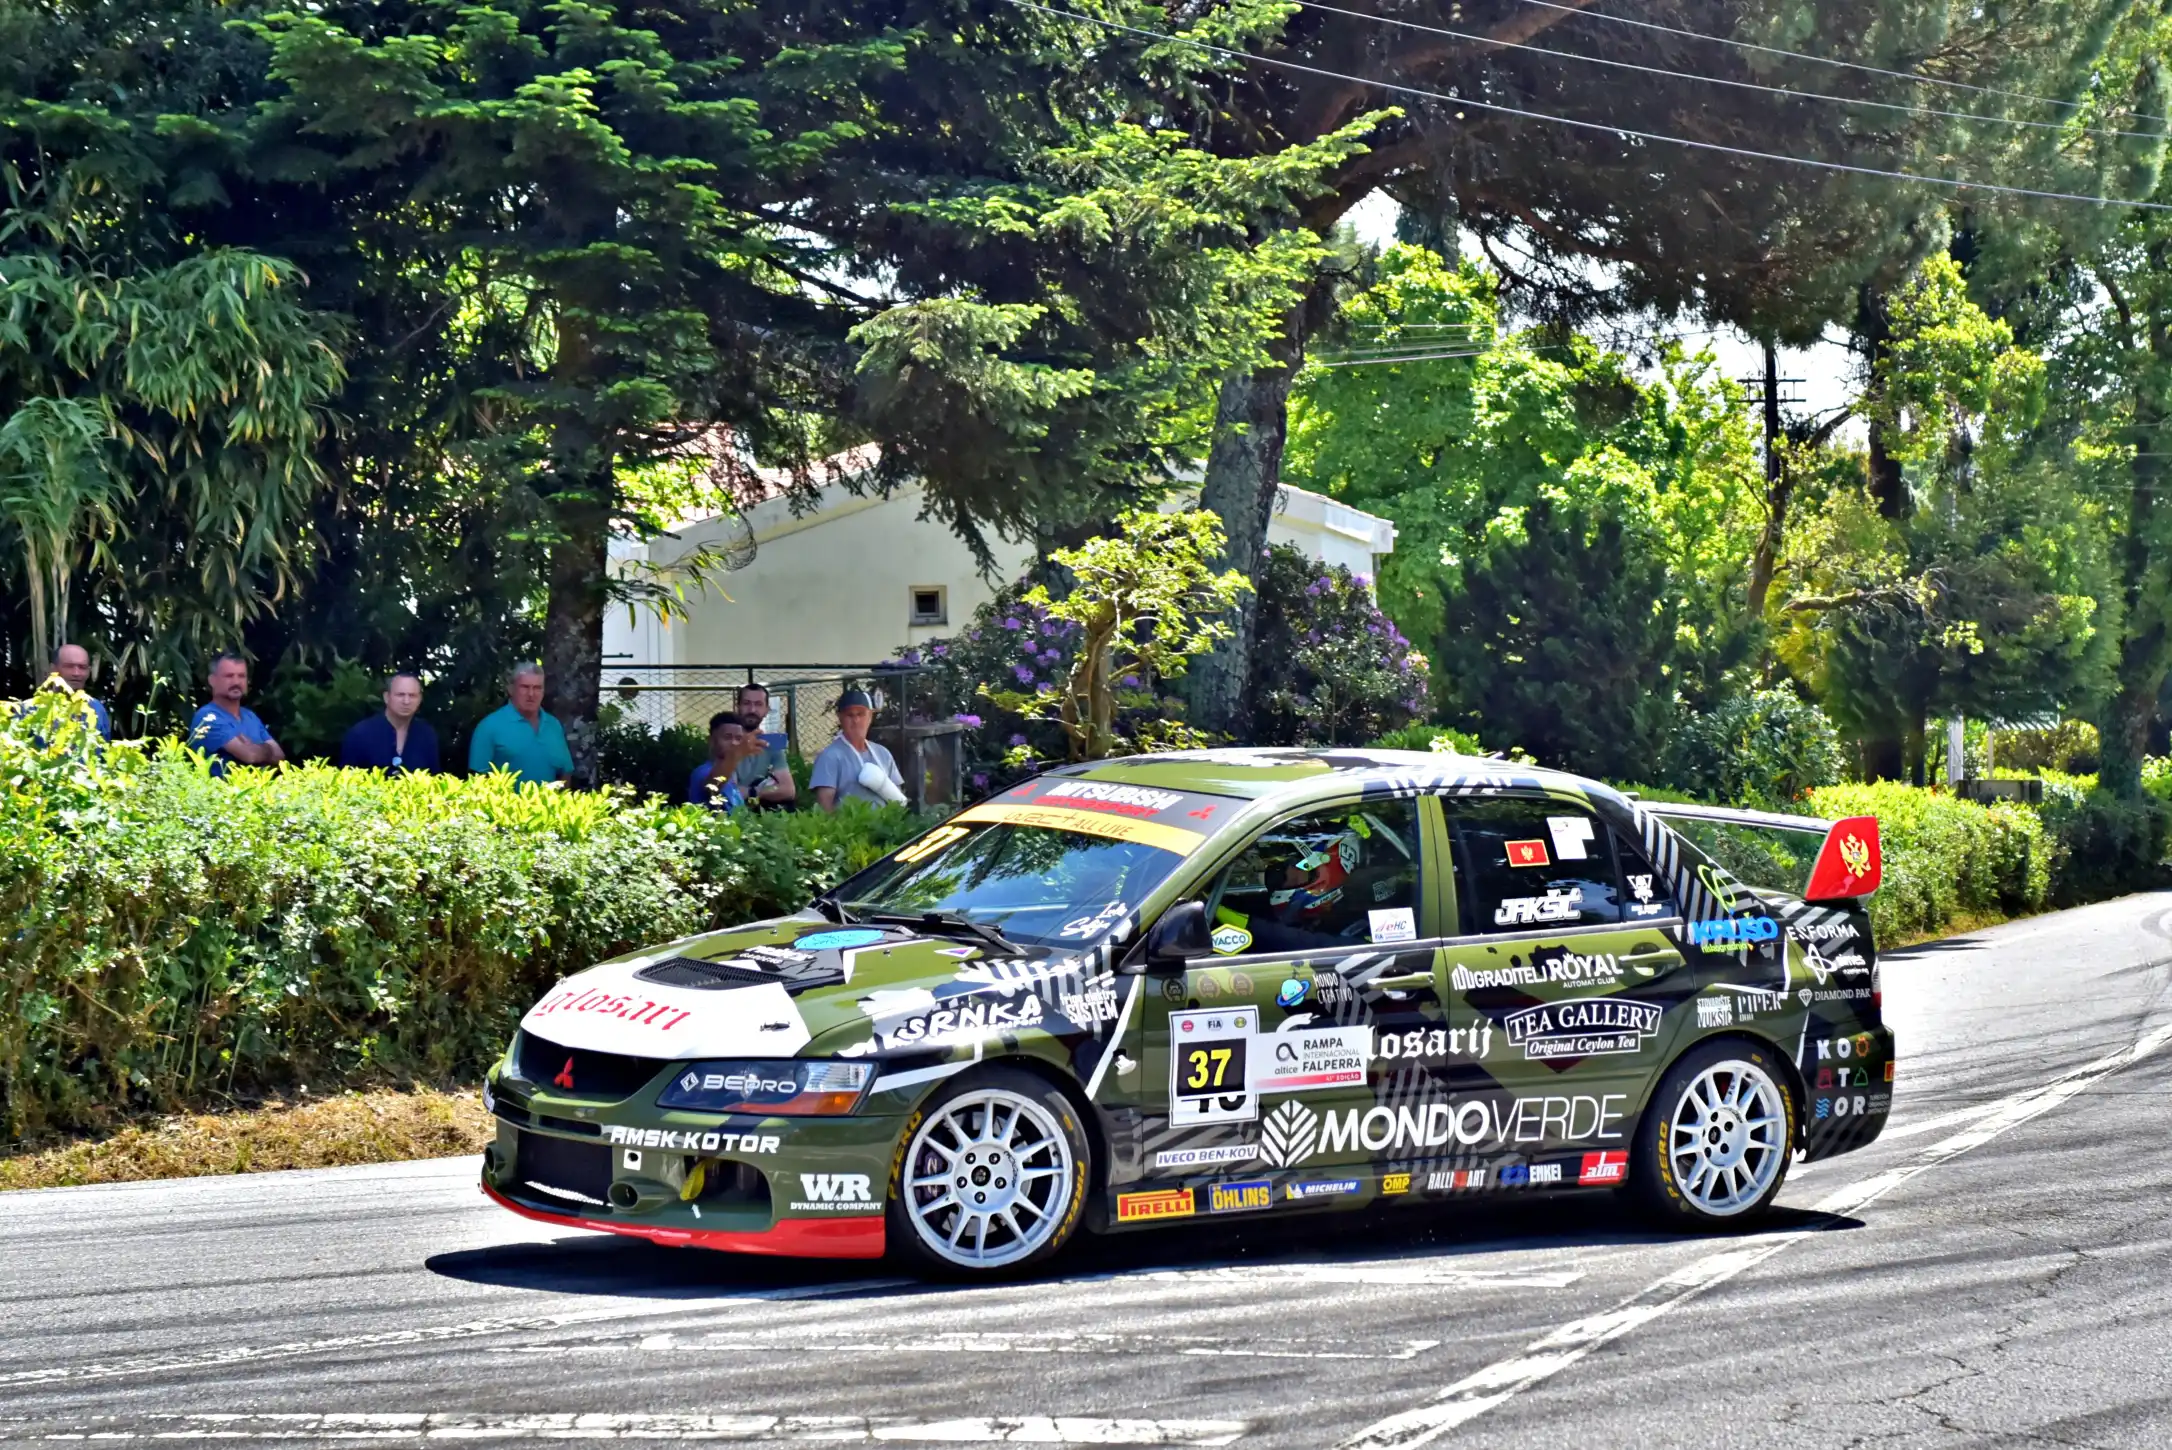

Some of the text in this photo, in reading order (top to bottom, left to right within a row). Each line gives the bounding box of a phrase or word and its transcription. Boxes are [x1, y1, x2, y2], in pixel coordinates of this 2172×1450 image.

[1071, 818, 1096, 832] ALL
[1098, 822, 1134, 837] LIVE
[1546, 953, 1624, 981] ROYAL
[1563, 977, 1616, 989] AUTOMAT CLUB
[1814, 988, 1871, 1002] DIAMOND PAK
[1066, 999, 1119, 1024] SISTEM
[1510, 1002, 1660, 1040] TEA GALLERY
[1303, 1037, 1344, 1051] RAMPA
[1529, 1035, 1636, 1056] Original Ceylon Tea
[1304, 1048, 1360, 1060] INTERNACIONAL
[1187, 1048, 1232, 1089] 37
[1274, 1065, 1299, 1075] altice
[1302, 1057, 1362, 1073] FALPERRA
[610, 1126, 781, 1154] AMSK KOTOR
[1158, 1146, 1257, 1164] IVECO BEN-KOV
[1658, 1121, 1674, 1185] ZERO
[1529, 1164, 1561, 1182] ENKEI
[800, 1173, 873, 1202] WR
[1305, 1181, 1356, 1195] MICHELIN
[1382, 1176, 1411, 1192] OMP
[791, 1202, 882, 1211] DYNAMIC COMPANY
[1119, 1190, 1192, 1218] PIRELLI
[1213, 1186, 1270, 1210] ÖHLINS
